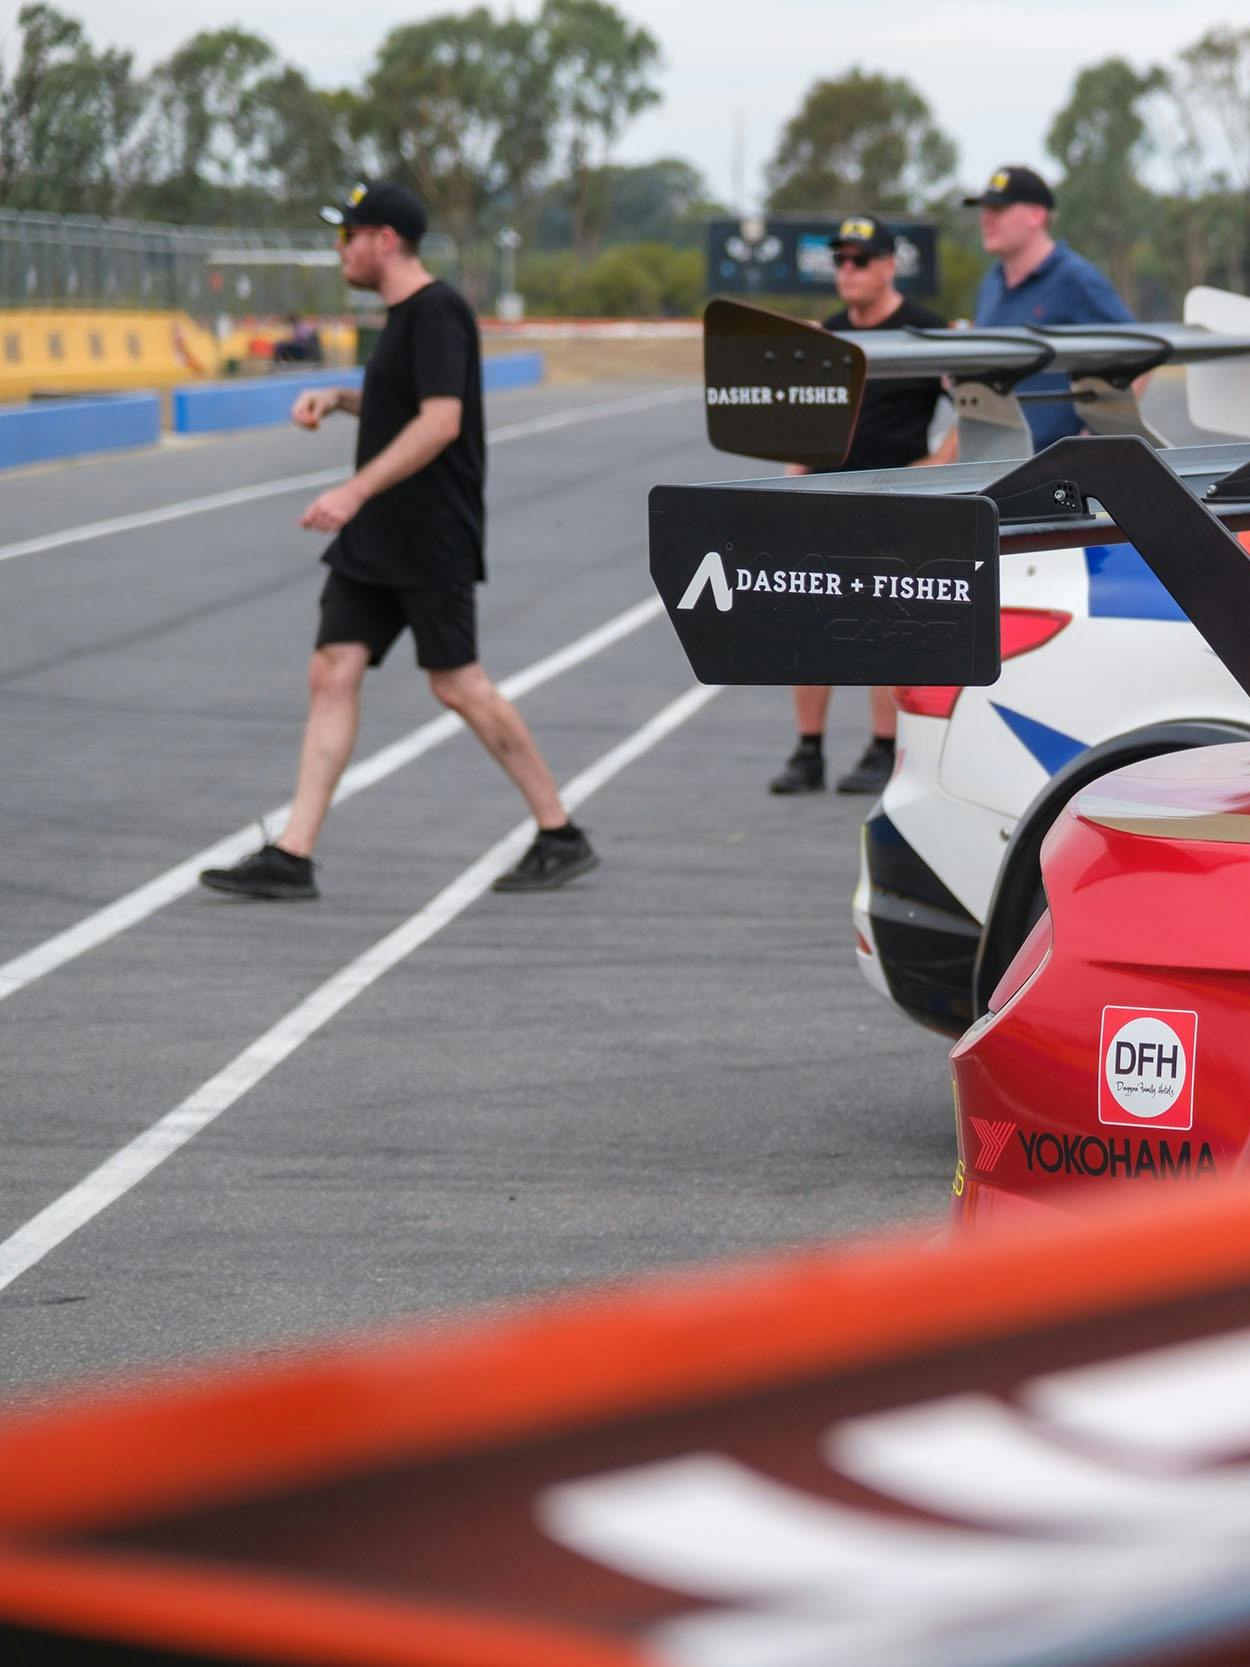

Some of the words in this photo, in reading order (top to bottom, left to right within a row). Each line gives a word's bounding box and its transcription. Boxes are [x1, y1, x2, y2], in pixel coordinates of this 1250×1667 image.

[706, 387, 772, 405] DASHER
[775, 389, 785, 401] +
[788, 386, 849, 404] FISHER
[736, 568, 842, 596] DASHER
[851, 578, 864, 593] +
[872, 575, 971, 602] FISHER
[1114, 1041, 1178, 1079] DFH
[1018, 1131, 1219, 1182] YOKOHAMA
